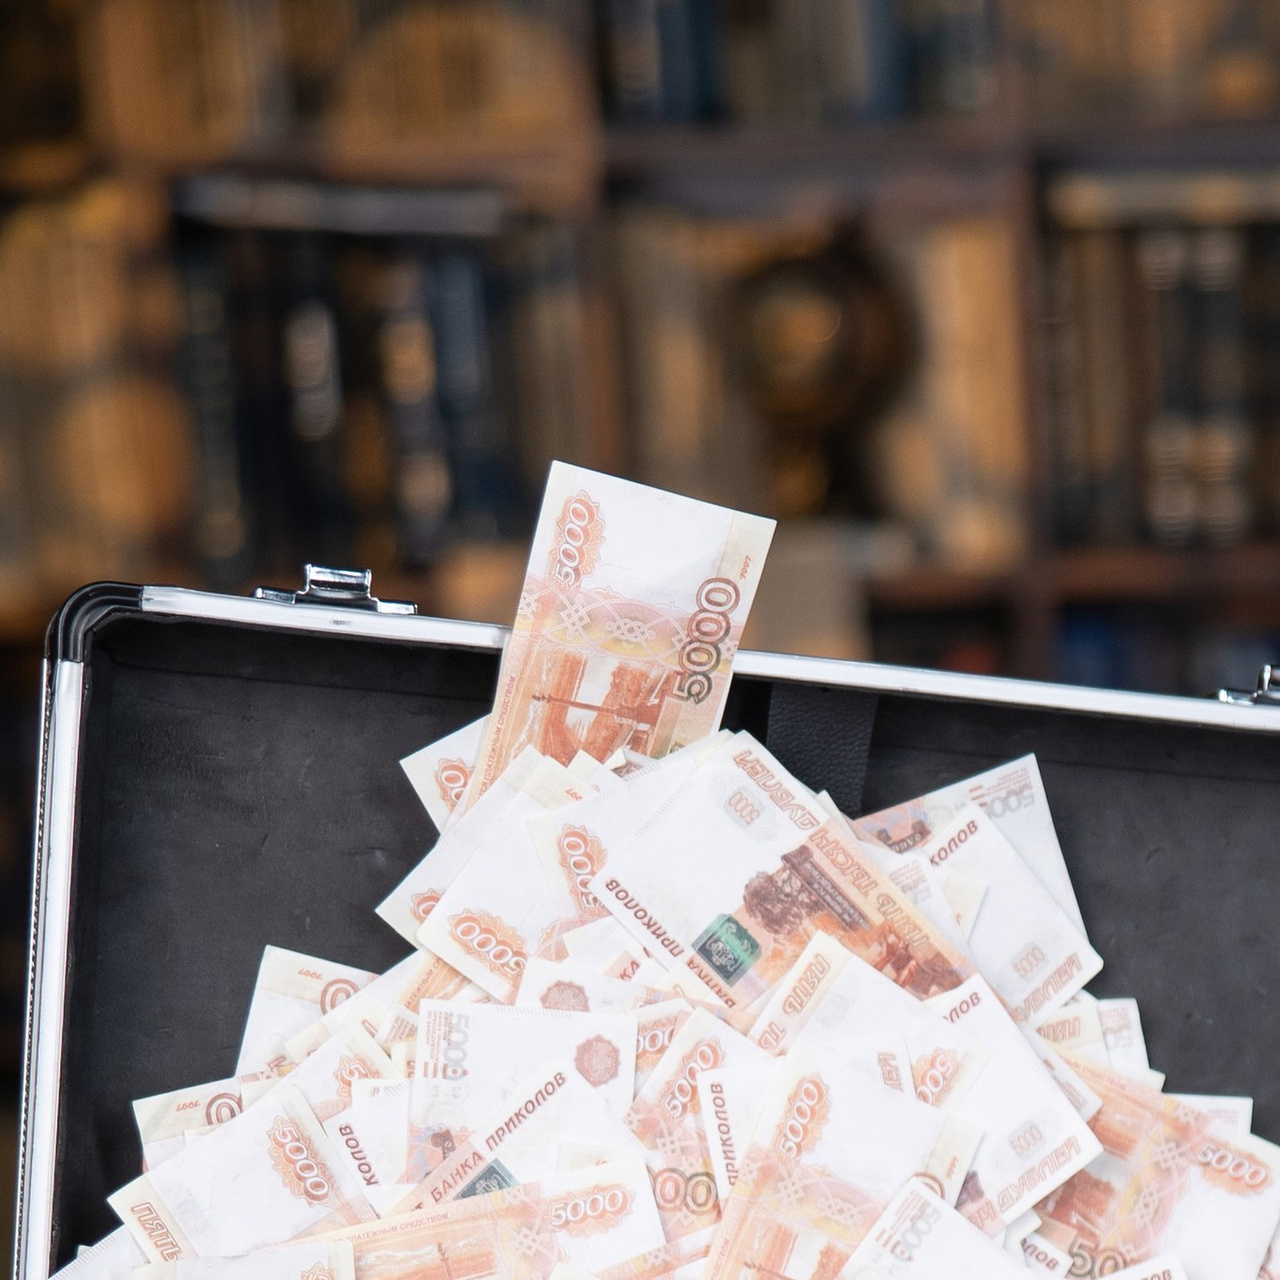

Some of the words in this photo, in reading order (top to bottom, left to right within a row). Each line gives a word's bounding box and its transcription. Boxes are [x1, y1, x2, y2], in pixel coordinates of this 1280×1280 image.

[554, 501, 594, 587] 5000
[672, 577, 740, 705] 5000
[732, 749, 819, 831] ДУБЛЕЙ
[812, 832, 880, 897] ТЫСЯЧ
[929, 821, 979, 867] КОЛОВ
[455, 920, 526, 976] 5000
[605, 877, 683, 957] ПРИКОЛОВ
[876, 893, 929, 948] ПЯТЬ
[783, 952, 832, 1014] ПЯТЬ
[447, 1013, 470, 1082] 5000
[665, 1045, 720, 1120] 5000
[339, 1123, 379, 1187] КОЛОВ
[430, 1151, 484, 1202] БАНКА
[485, 1072, 566, 1151] ПРИКОЛОВ
[711, 1080, 737, 1186] ПРИКОЛОВ
[780, 1084, 822, 1159] 5000
[273, 1129, 328, 1199] 5000
[999, 1137, 1081, 1212] ДУБЛЕЙ
[1197, 1145, 1267, 1187] 5000
[131, 1202, 183, 1261] ПЯТЬ
[550, 1189, 627, 1227] 5000
